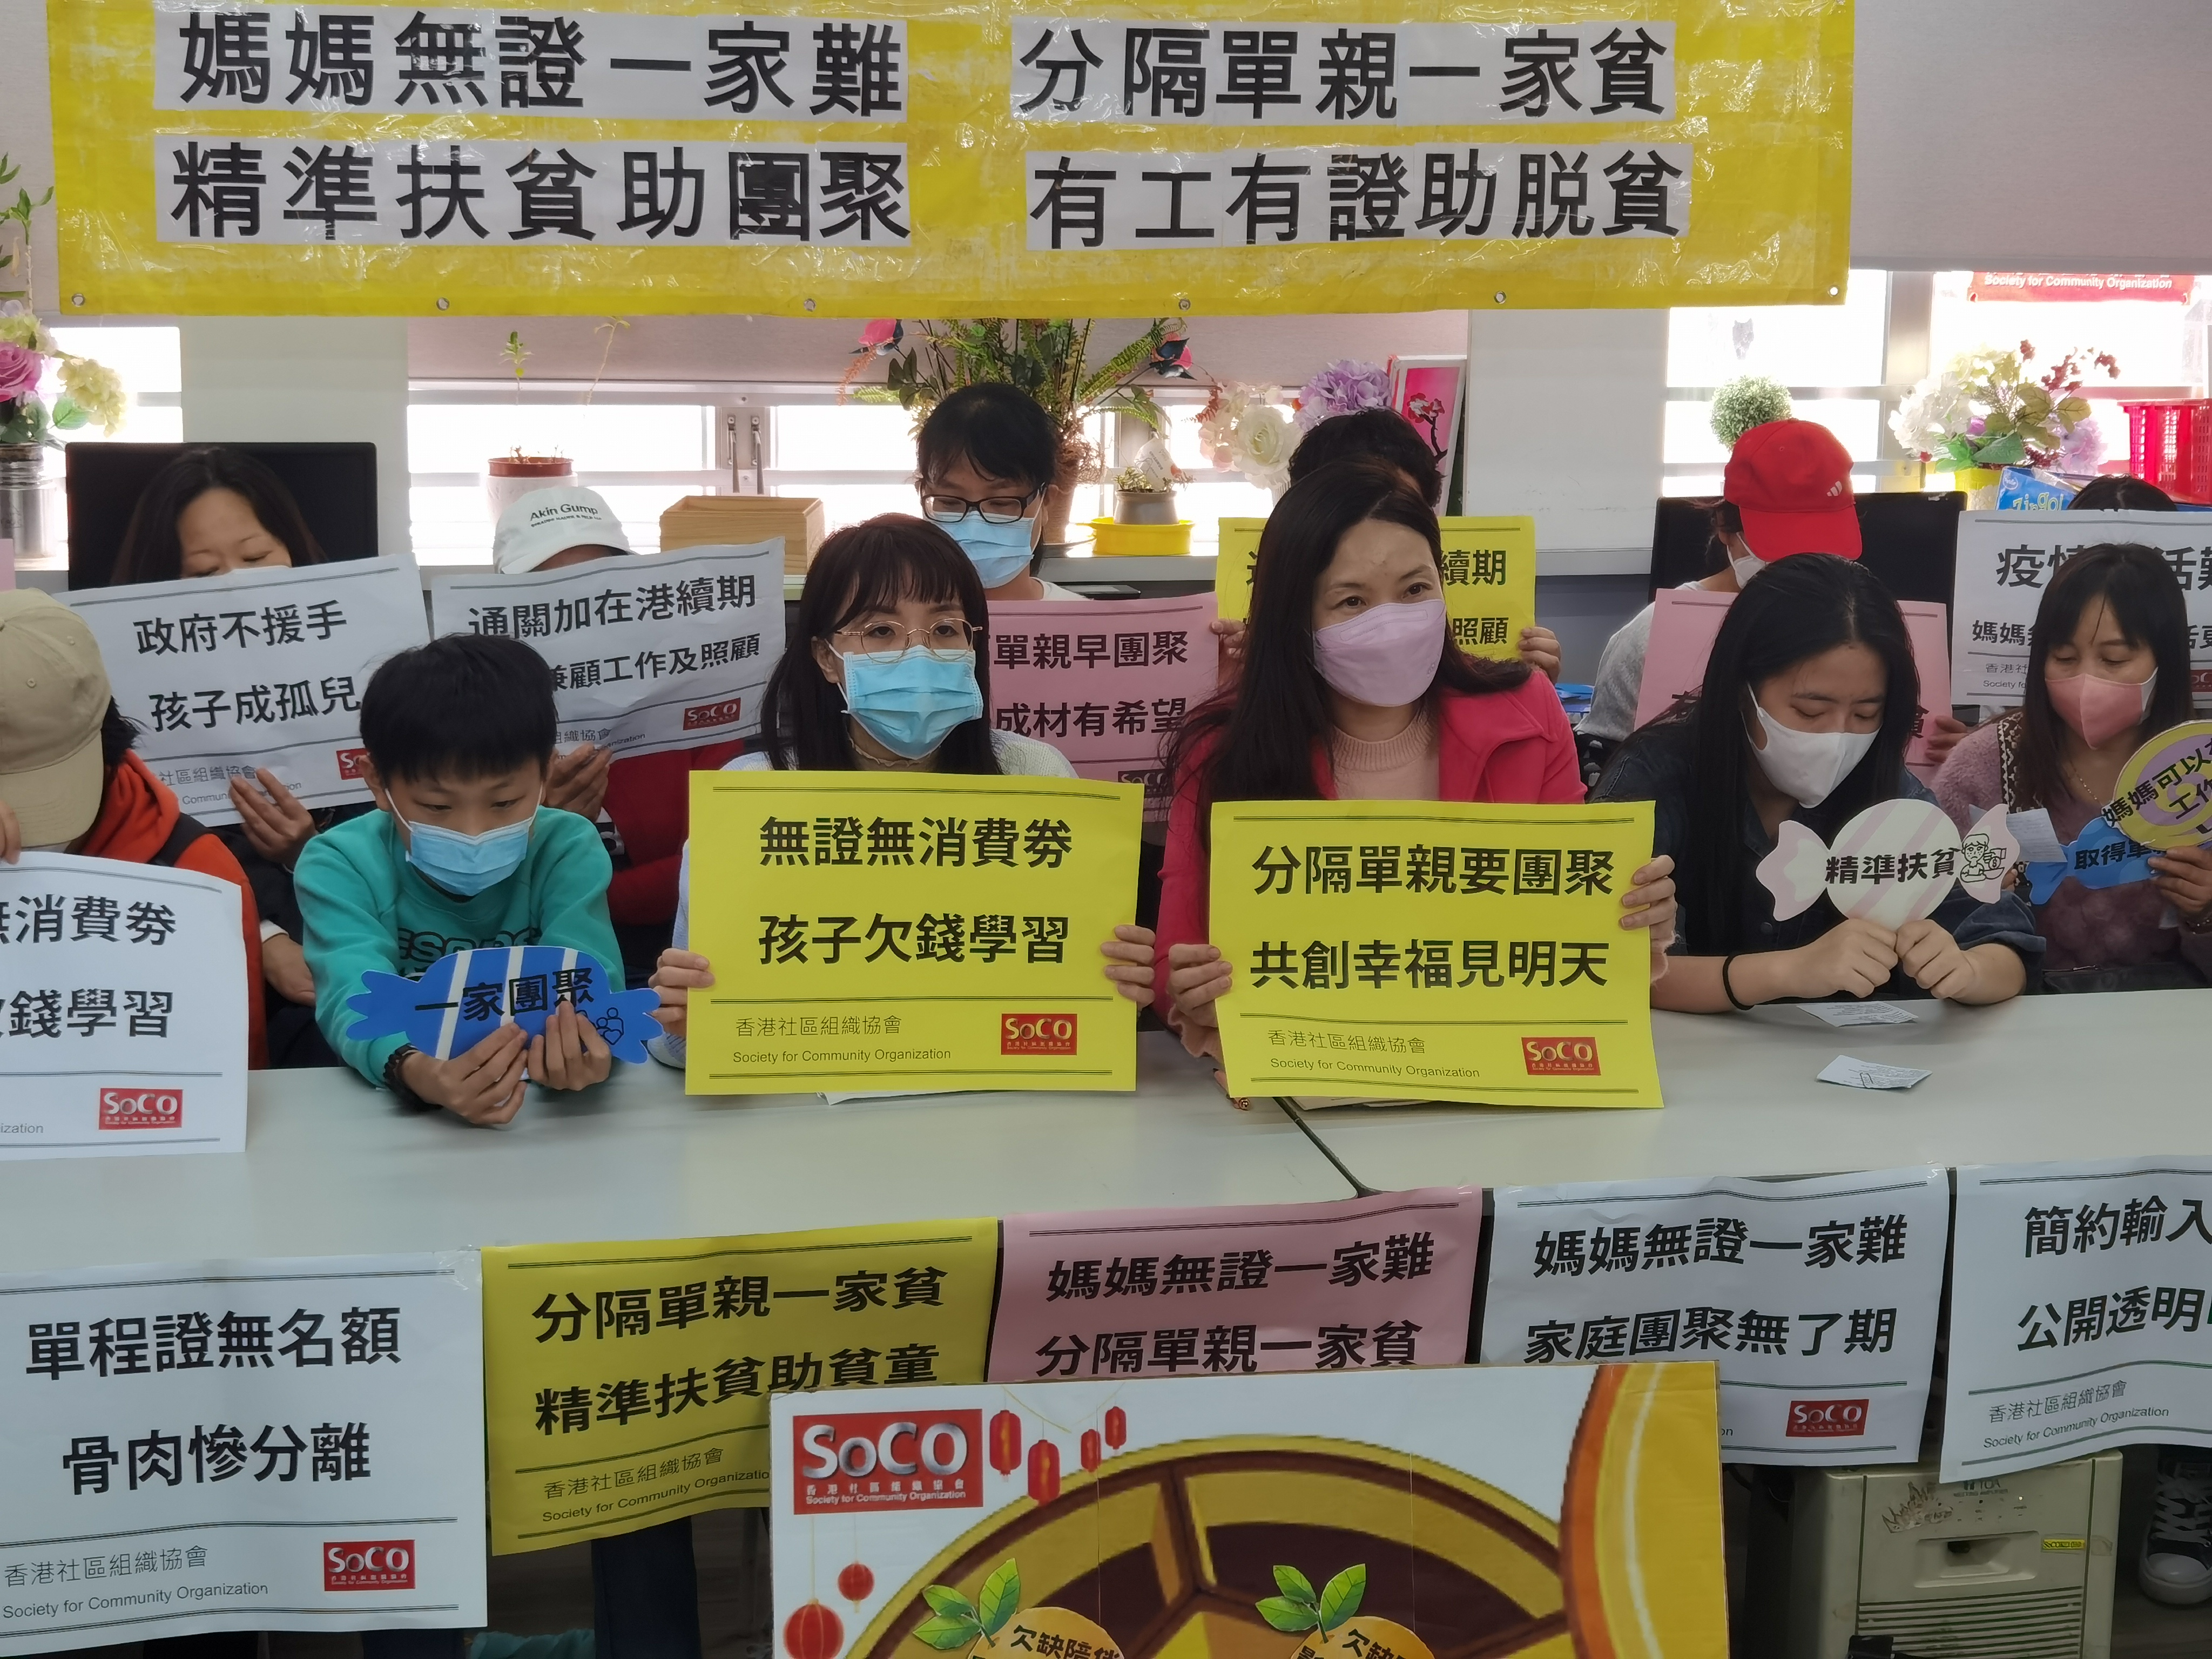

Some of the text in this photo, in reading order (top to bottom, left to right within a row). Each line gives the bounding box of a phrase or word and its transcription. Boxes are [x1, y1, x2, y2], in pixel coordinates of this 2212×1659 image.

[178, 11, 1668, 120] 媽媽無證一家難 分隔單親一家貧
[172, 141, 911, 241] 精準扶貧助團聚
[1984, 275, 2173, 290] Society for Community Organization
[530, 507, 558, 521] Akin
[560, 503, 598, 515] Gump
[1441, 548, 1507, 586] 續期
[133, 599, 347, 657] 政府不援手
[468, 575, 756, 639] 通關加在港續期
[994, 630, 1189, 670] 單親早團聚
[1452, 616, 1509, 646] 照顧
[1972, 619, 2034, 646] 媽媽
[148, 676, 361, 732] 孩子成孤兒
[1983, 680, 2016, 690] Society
[687, 703, 737, 721] SoCO
[995, 697, 1188, 738] 成材有希望
[182, 793, 231, 805] Commun
[2102, 738, 2212, 827] 媽媽可以
[1251, 844, 1615, 896] 分隔單親要團聚
[1824, 846, 1960, 885] 精準扶貧
[758, 913, 1070, 966] 孩子欠錢學習
[1250, 939, 1610, 990] 共創幸福見明天
[0, 988, 174, 1038] 錢學習
[415, 967, 594, 1022] 一家團聚
[736, 1015, 902, 1037] 香港社區組織協會
[1005, 1017, 1073, 1040] SoCO
[1267, 1029, 1426, 1054] 香港社區組織協會
[733, 1048, 951, 1064] Society for Community Organization
[1270, 1057, 1480, 1078] Society for Community Organization
[1526, 1041, 1593, 1062] SoCO
[104, 1092, 178, 1115] SoCO
[1047, 1231, 1434, 1301] 媽媽無證一家難
[1533, 1213, 1908, 1278] 媽媽無證一家難
[531, 1266, 948, 1343] 分隔單親一家貧
[2017, 1285, 2212, 1352] 公開透明
[25, 1306, 402, 1380] 單程證無名額
[1035, 1319, 1424, 1378] 分隔單親一家貧
[1523, 1306, 1898, 1364] 家庭團聚無了期
[535, 1343, 941, 1437] 精準扶貧助貧童
[1988, 1379, 2127, 1424] 香港社區組織協會
[1793, 1404, 1863, 1424] SoCO
[1983, 1407, 2169, 1449] Society for Community Organization
[62, 1421, 372, 1496] 骨肉慘分離
[802, 1421, 968, 1479] SoCO
[544, 1447, 724, 1500] 香港社區組織協會
[542, 1470, 770, 1522] Society for Community Organizatio
[806, 1491, 966, 1505] Society for Community Organization
[4, 1545, 208, 1588] 香港社區組織協會
[328, 1546, 409, 1573] SoCO
[3, 1582, 269, 1619] Society for Community Organization
[1342, 1628, 1406, 1659] 欠缺
